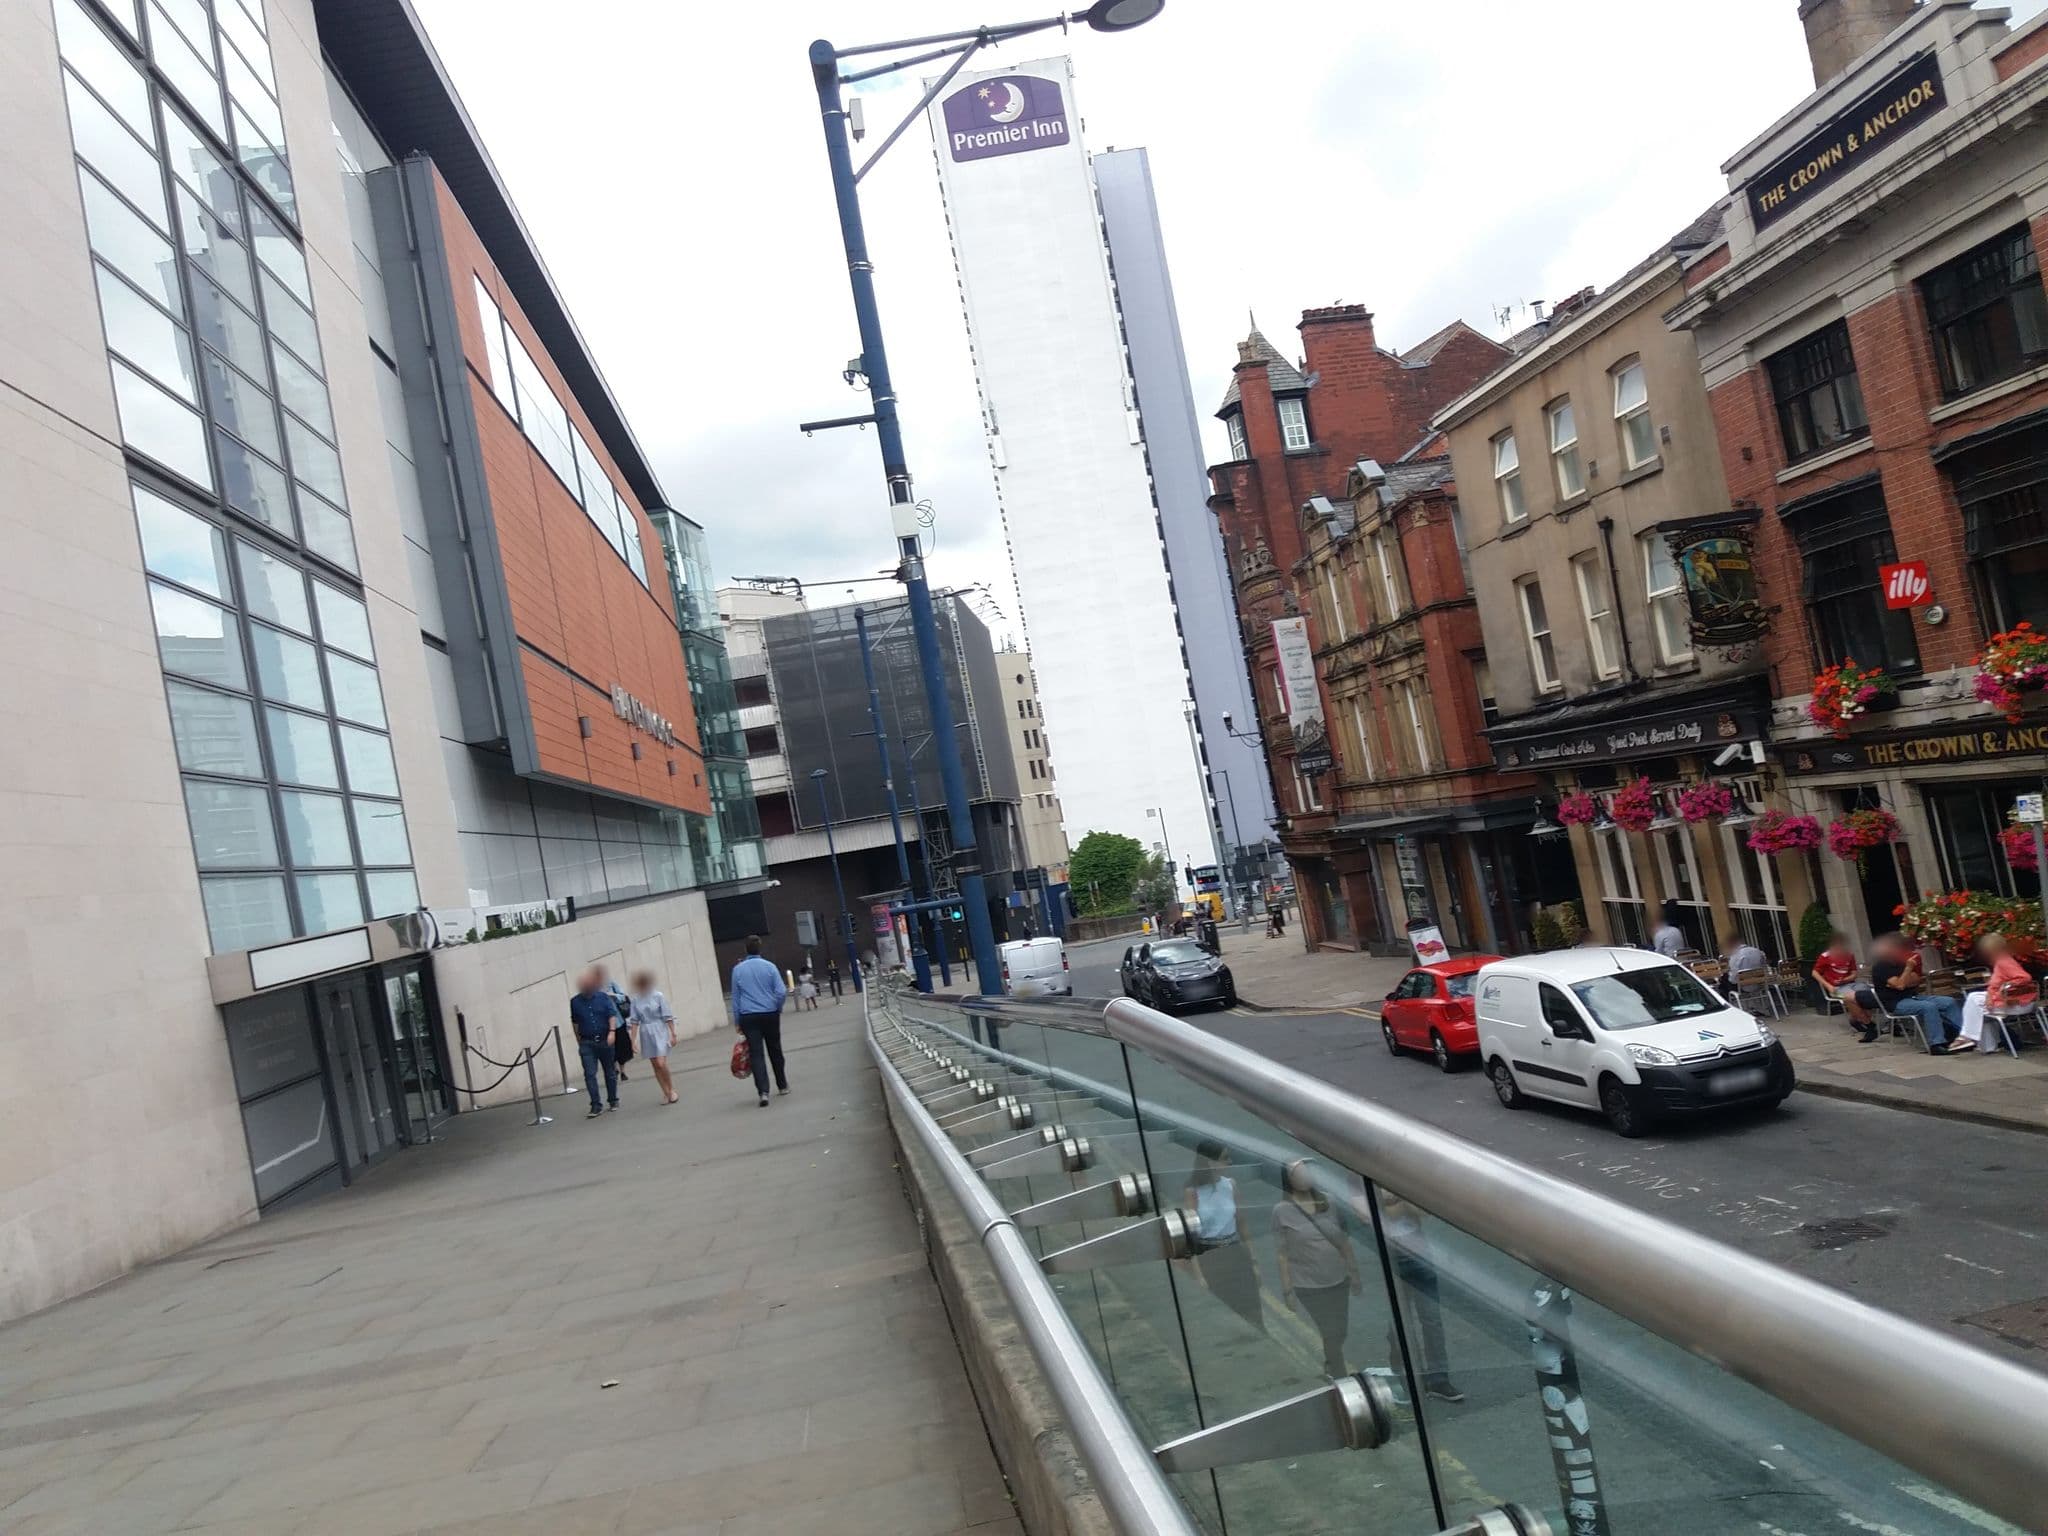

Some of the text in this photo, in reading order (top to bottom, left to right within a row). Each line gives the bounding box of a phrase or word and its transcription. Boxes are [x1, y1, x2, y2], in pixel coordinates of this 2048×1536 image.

[953, 120, 1064, 151] Premier Inn
[1759, 79, 1935, 213] THE CROWN & ANCHOR
[1889, 568, 1927, 602] illy
[1864, 743, 1900, 764] THE
[1903, 734, 1975, 761] CROWN
[1982, 731, 1998, 753] &
